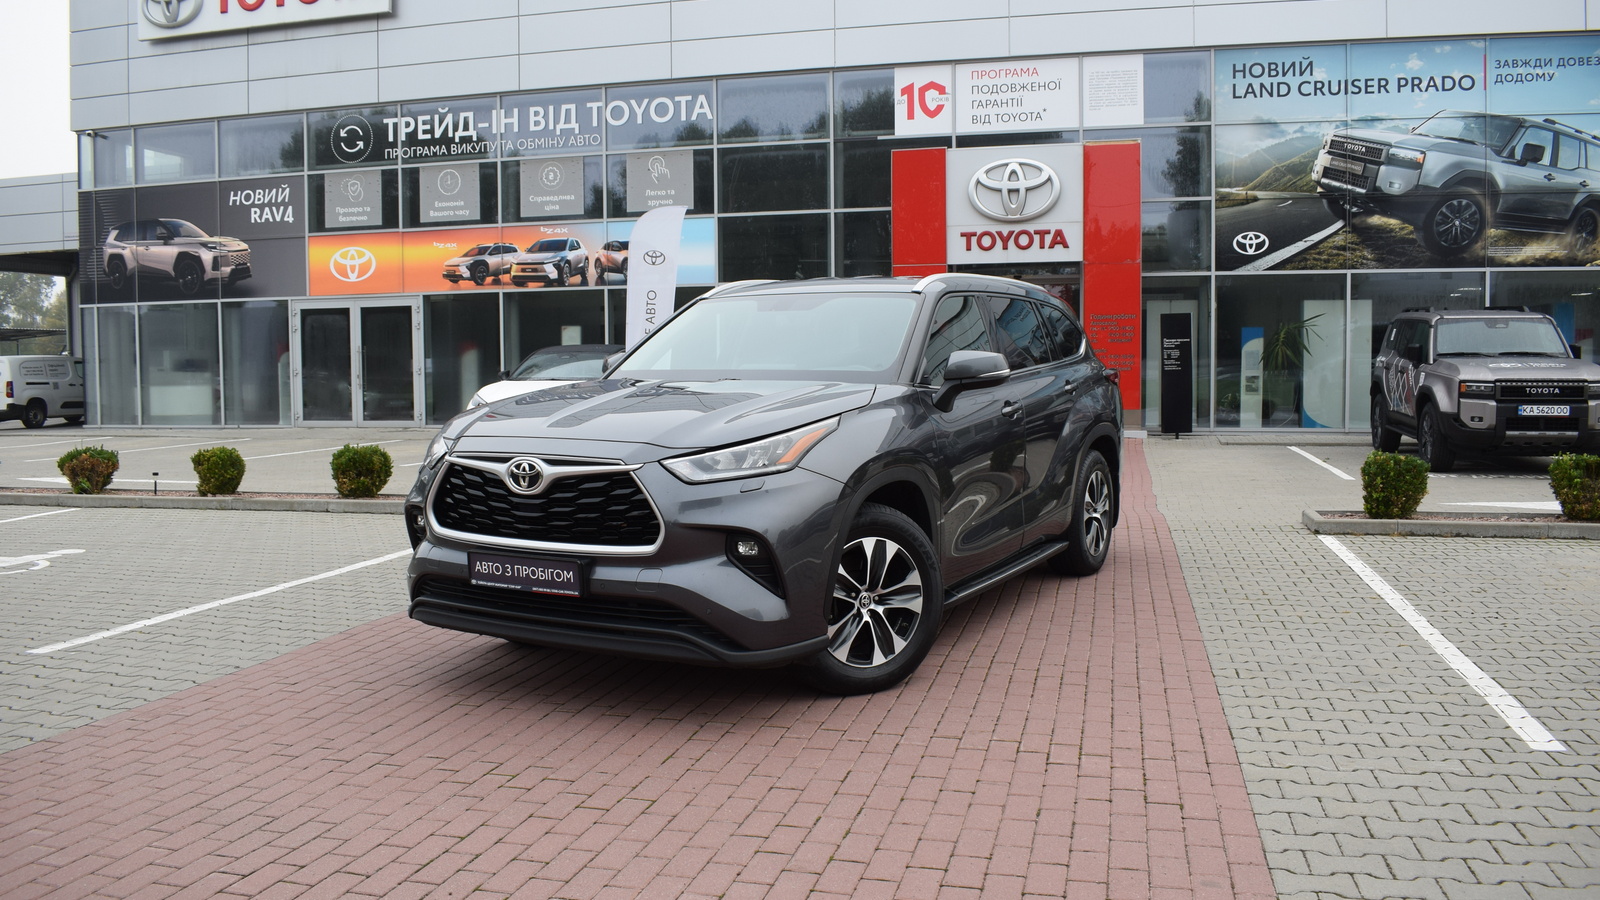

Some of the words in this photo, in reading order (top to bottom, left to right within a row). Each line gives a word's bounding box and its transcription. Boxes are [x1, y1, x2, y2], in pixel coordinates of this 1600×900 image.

[1232, 57, 1314, 80] НОВИЙ
[1494, 57, 1553, 70] ЗАВЖДИ
[971, 67, 1039, 80] ПРОГРАМА
[1494, 72, 1555, 85] ДОДОМУ
[971, 78, 1062, 96] ПОДОВЖЕНОЇ
[1232, 81, 1291, 99] LAND
[1297, 78, 1389, 97] CRUISER
[1396, 75, 1476, 94] PRADO
[971, 95, 1024, 110] ГАРАНТІЇ
[383, 107, 519, 142] ТРЕЙД-ІН
[529, 103, 580, 136] ВІД
[586, 94, 714, 127] TOYOTA
[971, 114, 991, 126] ВІД
[384, 145, 448, 161] ПРОГРАМА
[450, 141, 498, 156] ВИКУПУ
[499, 139, 516, 150] ТА
[517, 136, 566, 150] ОБМІНУ
[568, 133, 601, 147] АВТО
[1344, 143, 1366, 153] TOYOTA
[229, 184, 290, 206] НОВИЙ
[529, 194, 575, 203] Справедлива
[250, 206, 294, 223] RAV4
[960, 229, 1069, 251] TOYOTA
[645, 290, 657, 325] АВТО
[1522, 406, 1534, 414] KA
[1537, 406, 1555, 415] 5620
[475, 561, 502, 575] АВТО
[514, 565, 574, 583] ПРОБІГОМ
